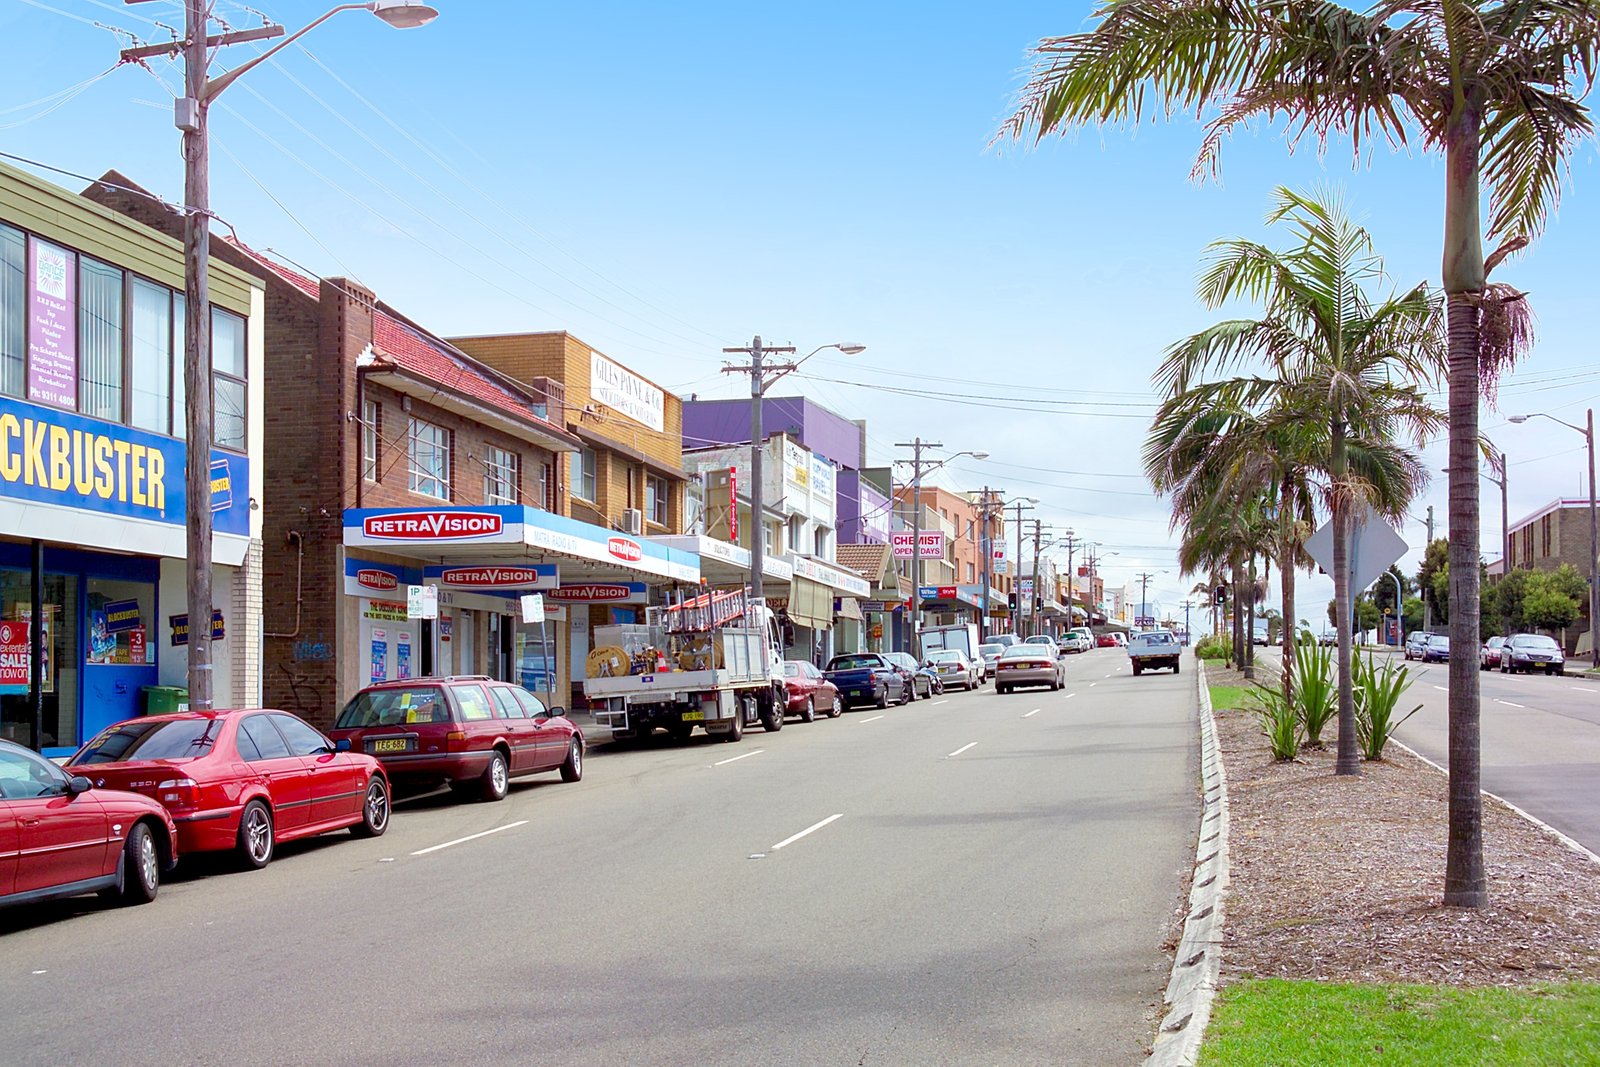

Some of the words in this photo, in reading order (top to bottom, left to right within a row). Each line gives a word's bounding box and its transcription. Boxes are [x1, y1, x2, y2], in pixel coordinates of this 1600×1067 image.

[41, 389, 57, 402] 9311
[920, 547, 940, 555] DAYS
[108, 608, 139, 623] BLOCKBUSTER
[0, 653, 27, 668] SALE
[0, 669, 18, 679] now
[18, 669, 28, 679] on
